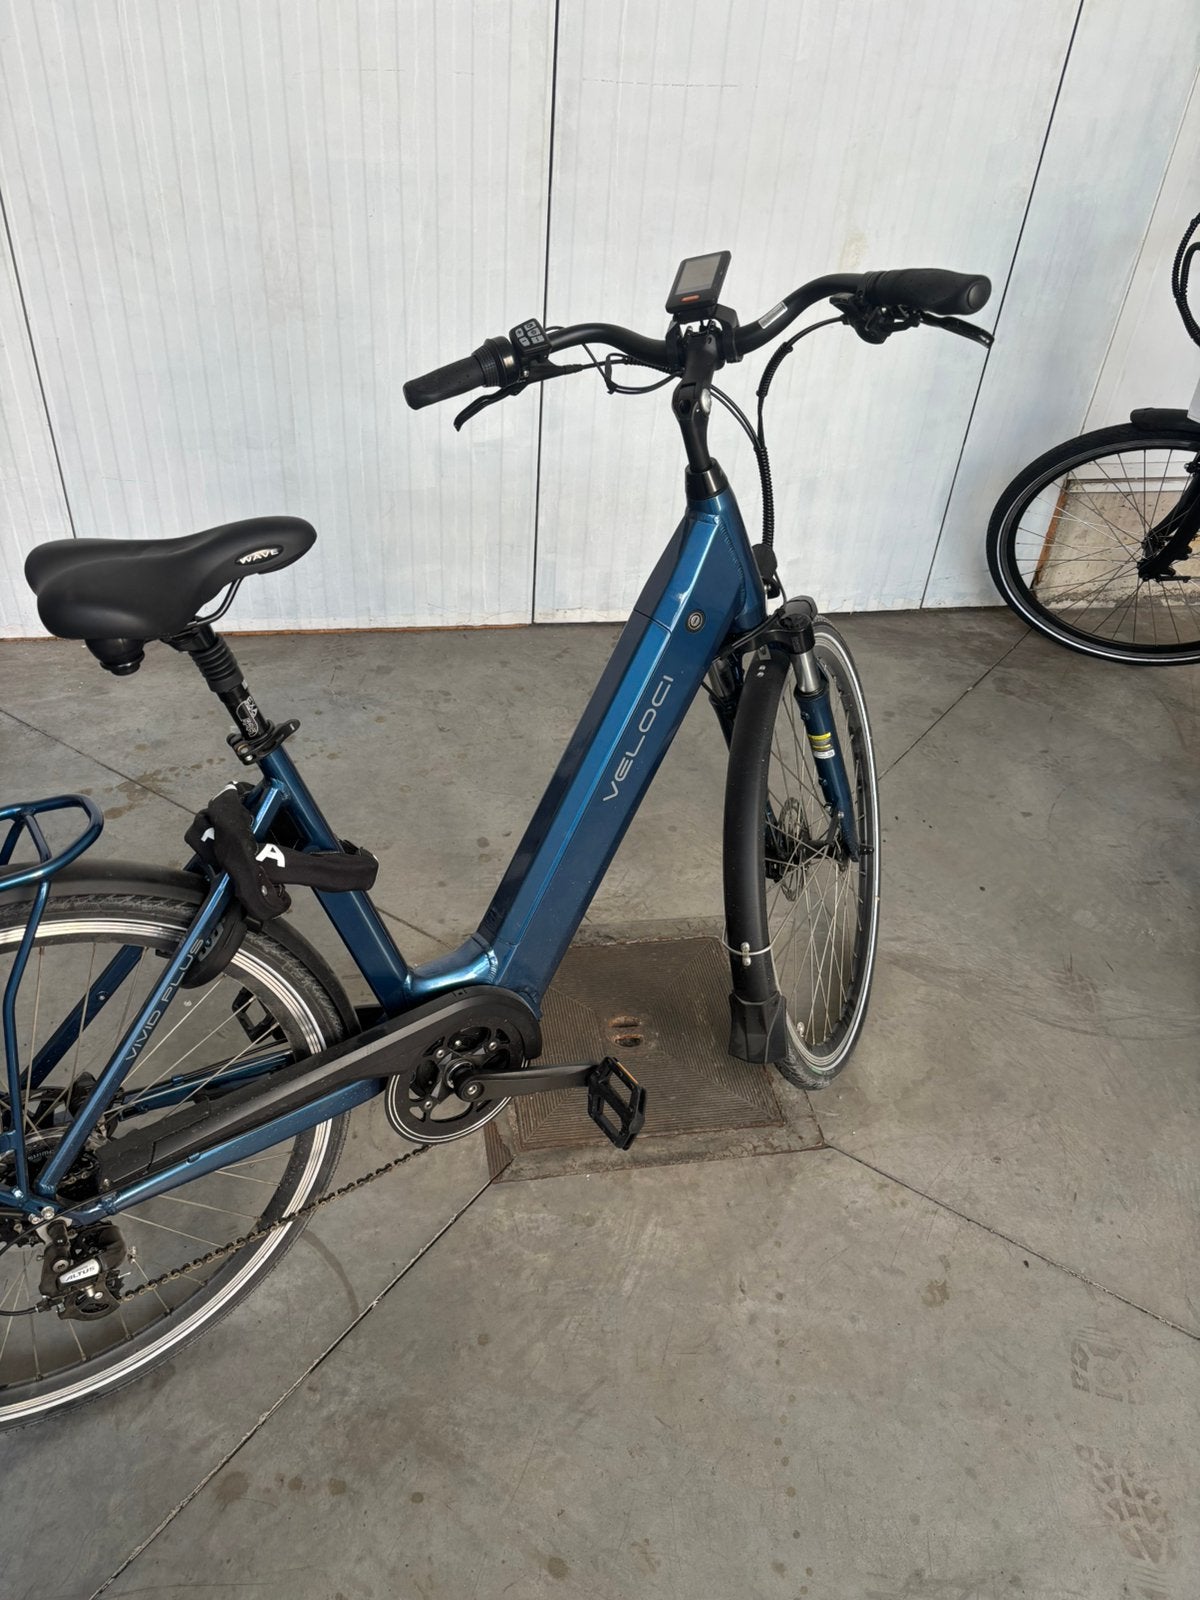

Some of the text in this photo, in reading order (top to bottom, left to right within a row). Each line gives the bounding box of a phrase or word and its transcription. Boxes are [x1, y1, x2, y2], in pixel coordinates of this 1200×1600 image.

[239, 548, 279, 564] WAVE
[603, 675, 674, 801] VELOCI
[125, 938, 204, 1061] VIVID PLUS
[65, 1266, 96, 1282] ALTUS
